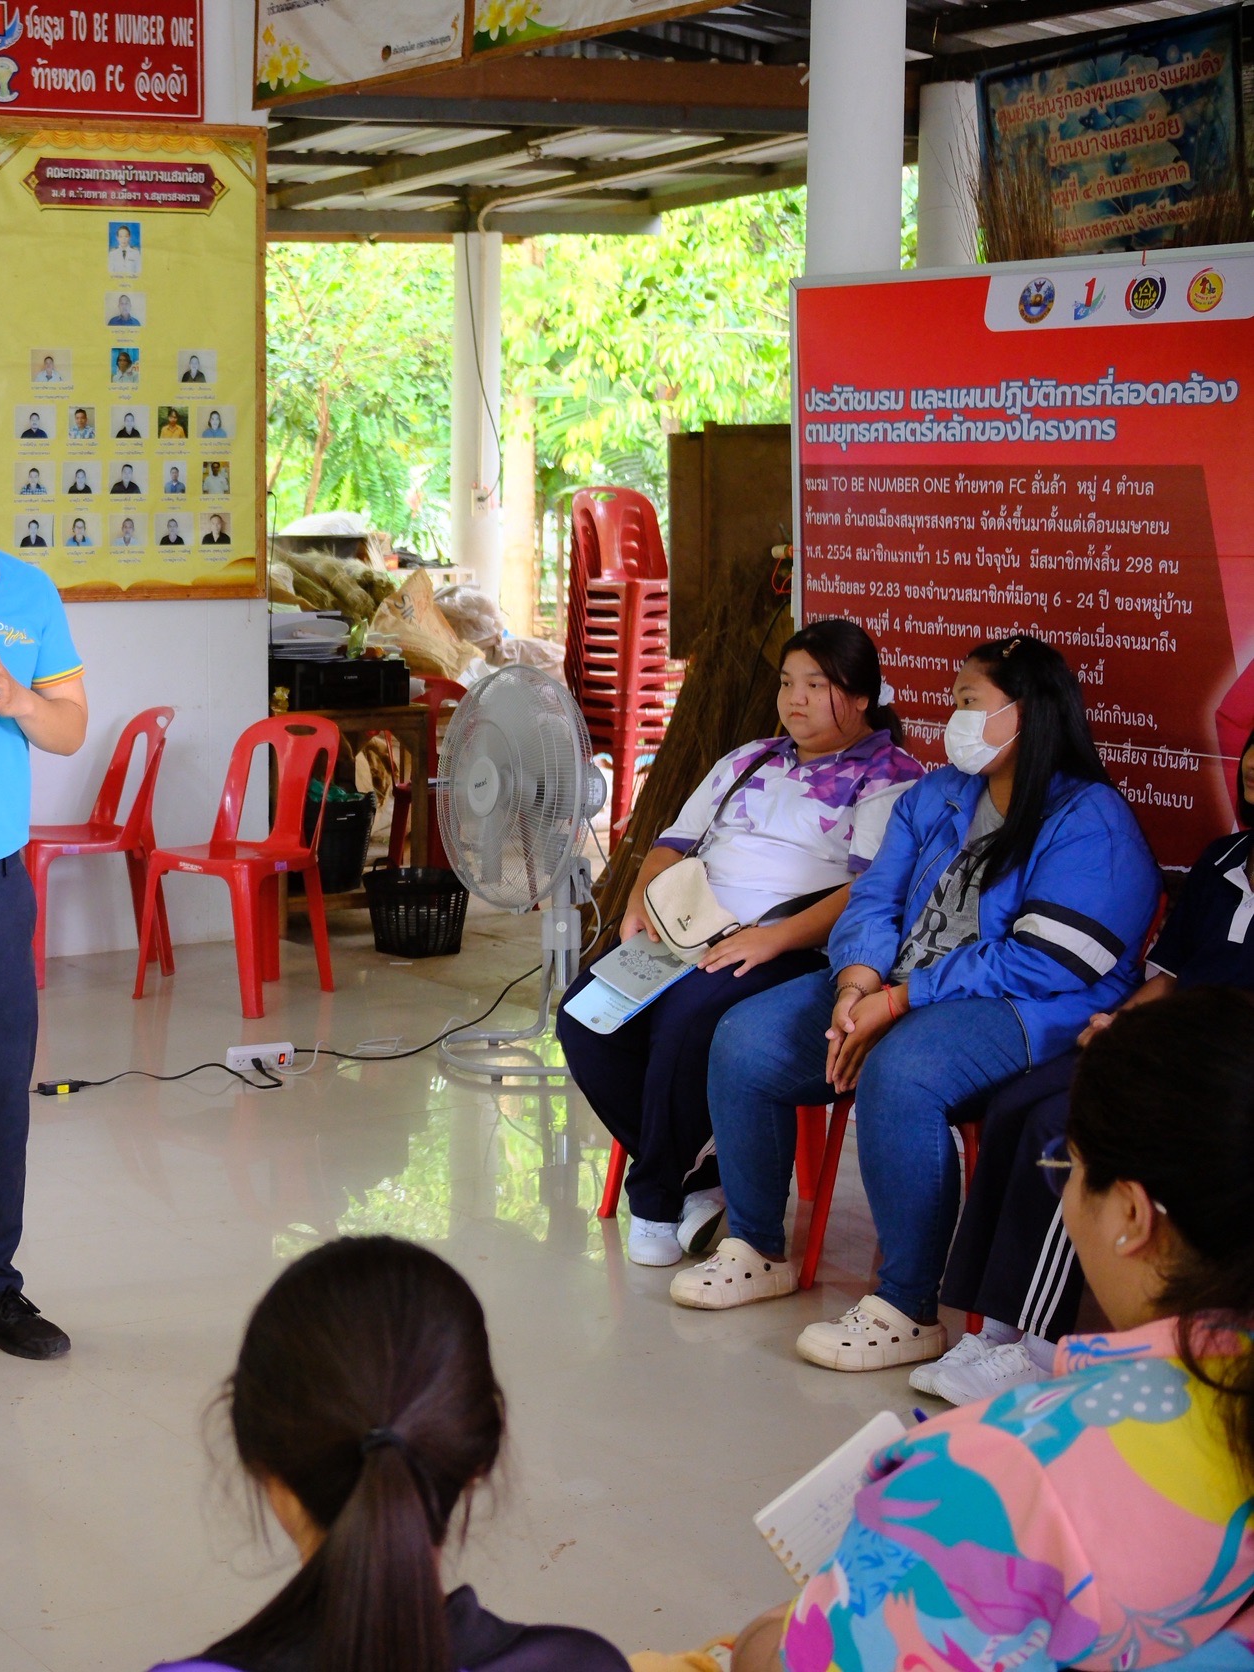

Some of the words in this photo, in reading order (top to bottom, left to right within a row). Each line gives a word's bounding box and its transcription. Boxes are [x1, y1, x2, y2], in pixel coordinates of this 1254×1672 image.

[69, 10, 87, 42] TO
[93, 13, 109, 43] BE
[115, 13, 166, 46] NUMBER
[171, 17, 195, 47] ONE
[31, 57, 96, 93] ท้ายหาด
[105, 64, 125, 93] FC
[1047, 114, 1181, 164] บ้านบางแสมน้อย
[1097, 162, 1187, 197] ตำบลท้ายหาด
[804, 383, 904, 412] ประวัติชมรม
[910, 366, 1239, 415] และแผนปฏิบัติการที่สอดคล้อง
[804, 412, 1117, 452] ตามยุทธศาสตร์หลักของโครงการ
[805, 478, 829, 492] ชมรม
[831, 476, 848, 492] TO
[851, 477, 865, 492] BE
[868, 477, 920, 493] NUMBER
[923, 477, 951, 494] ONE
[954, 473, 1004, 494] ท้ายหาด
[1008, 478, 1027, 494] FC
[1031, 469, 1067, 495] ลั่นล้า
[1077, 475, 1097, 502] หมู่
[1102, 478, 1112, 495] 4
[1116, 475, 1155, 496] ตำบล
[805, 505, 841, 527] ท้ายหาด
[844, 507, 975, 535] อำเภอเมืองสมุทรสงคราม
[980, 504, 1170, 536] จัดตั้งขึ้นมาตั้งแต่เดือนเมษายน
[806, 544, 825, 559] พ.ศ.
[827, 545, 852, 561] 2554
[855, 543, 931, 565] สมาชิกแรกเข้า
[935, 549, 950, 566] 15
[954, 551, 972, 567] คน
[975, 546, 1021, 574] ปัจจุบัน
[1029, 544, 1121, 572] มีสมาชิกทั้งสิ้น
[1125, 556, 1154, 574] 298
[1158, 559, 1180, 575] คน
[806, 572, 866, 596] คิดเป็นร้อยละ
[869, 580, 902, 599] 92.83
[904, 579, 1049, 614] ของจำนวนสมาชิกที่มีอายุ
[1052, 591, 1062, 608] 6
[1076, 592, 1095, 610] 24
[1098, 588, 1110, 611] ปี
[1114, 591, 1194, 621] ของหมู่บ้าน
[865, 608, 891, 638] หมู่ที่
[893, 617, 901, 633] 4
[904, 613, 982, 639] ตำบลท้ายหาด
[1077, 658, 1105, 686] ดังนี้
[898, 684, 919, 703] เช่น
[1085, 702, 1158, 731] กผักกินเอง,
[1097, 738, 1147, 768] ลุ่มเสี่ยง
[1152, 744, 1199, 772] เป็นต้น
